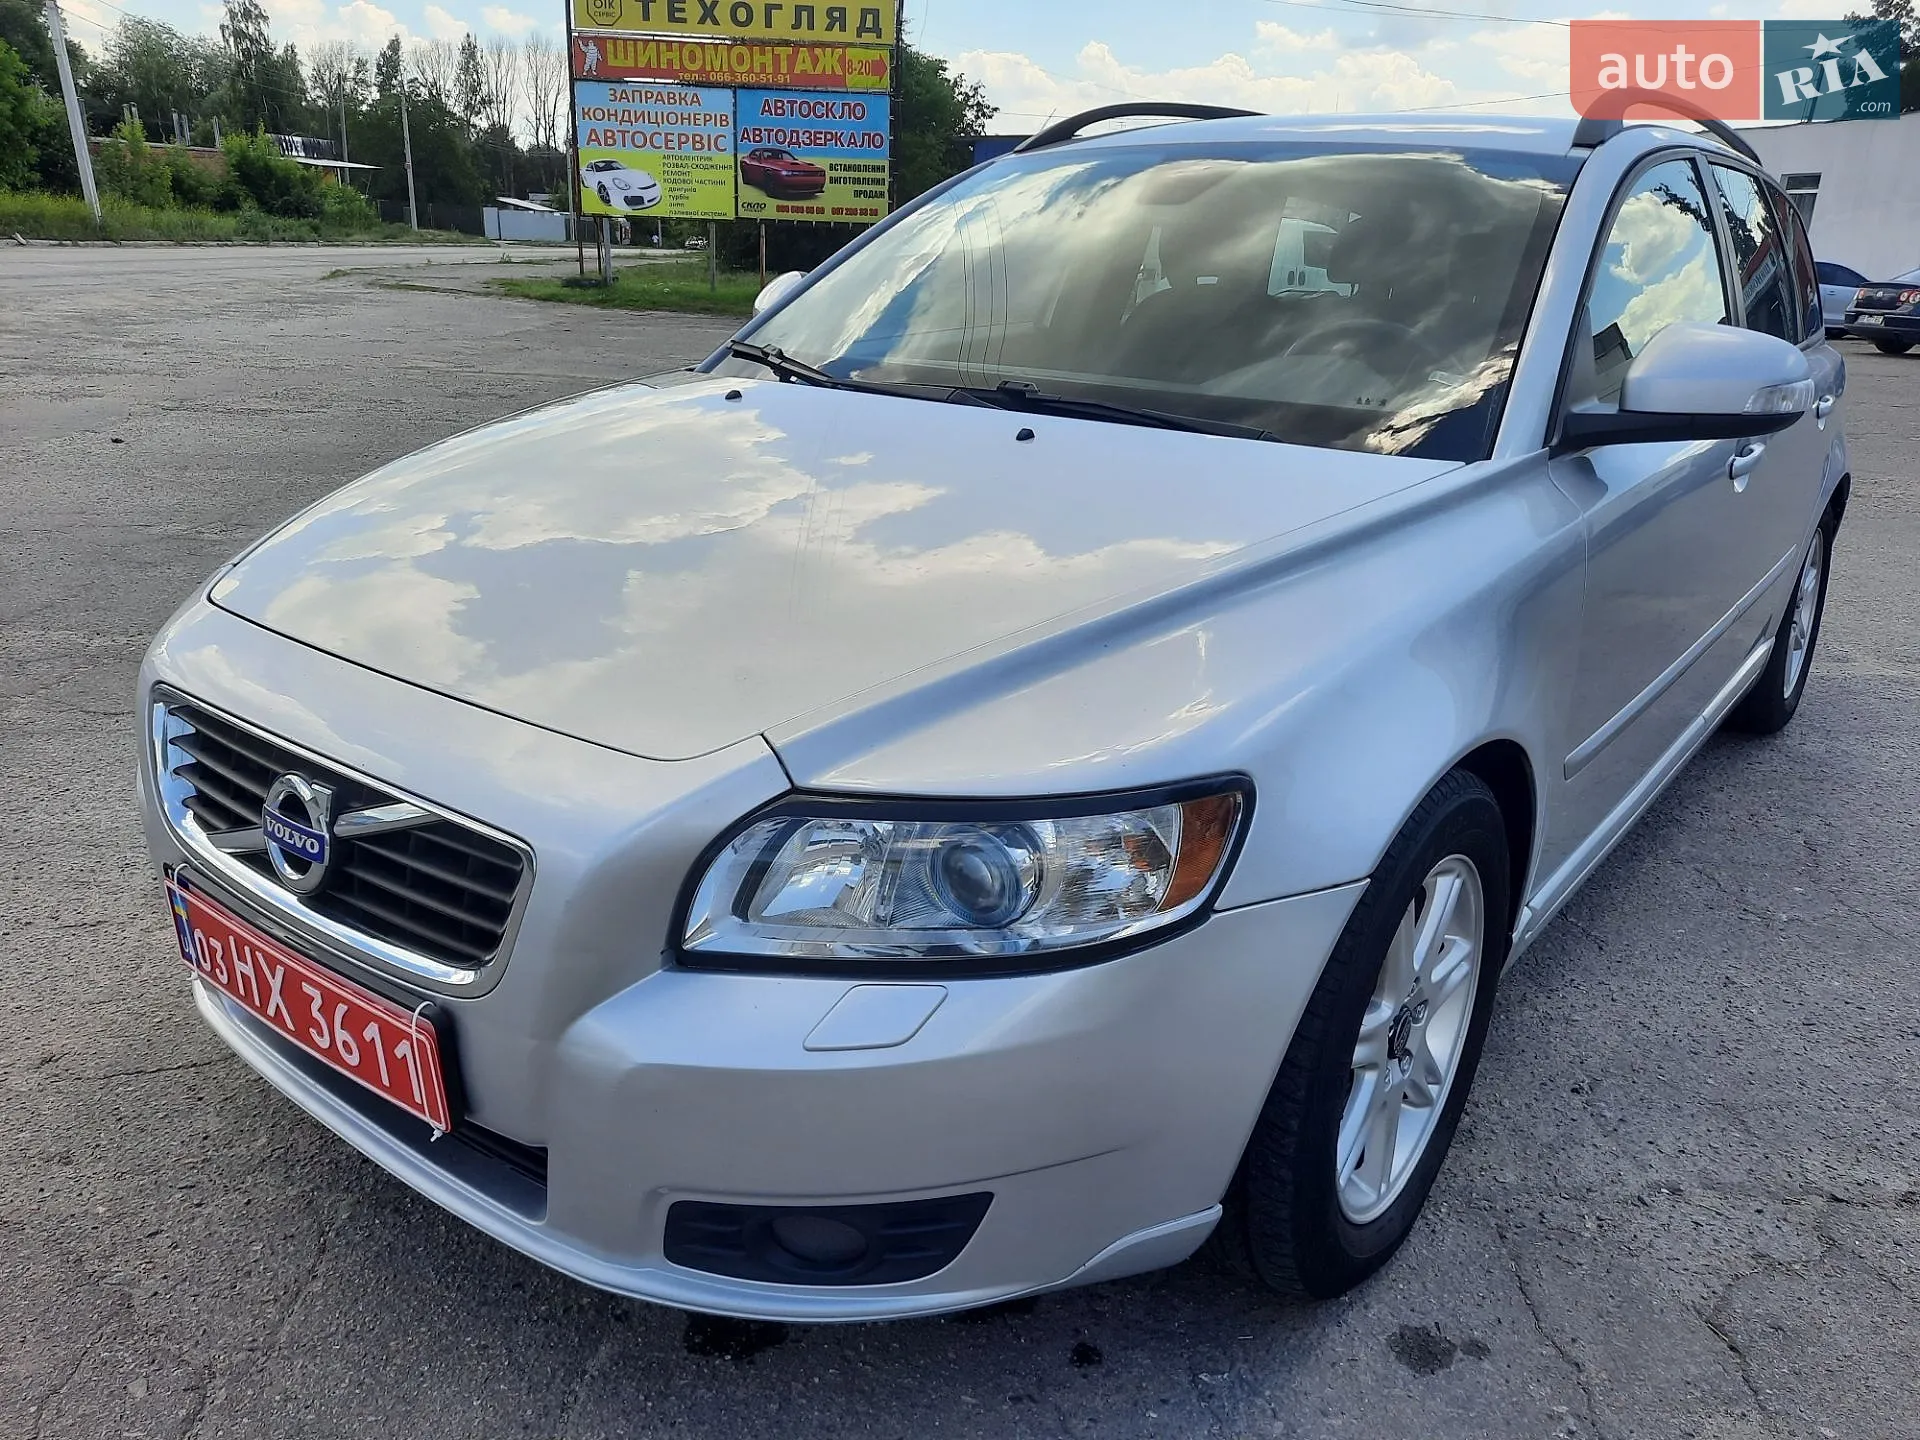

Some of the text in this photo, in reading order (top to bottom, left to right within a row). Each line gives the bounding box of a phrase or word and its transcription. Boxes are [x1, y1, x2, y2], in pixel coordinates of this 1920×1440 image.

[634, 0, 883, 39] ТЕХОГЛЯД
[606, 40, 844, 75] ШИНОМОНТАЖ
[847, 58, 872, 76] 8-20
[709, 72, 791, 83] 066-360-51-91
[608, 88, 703, 107] ЗАПРАВКА
[581, 107, 730, 128] КОНДИЦІОНЕРІВ
[760, 98, 867, 121] АВТОСКЛО
[585, 127, 728, 153] АВТОСЕРВІС
[739, 126, 885, 149] АВТОДЗЕРКАЛО
[829, 163, 886, 173] ВСТАНОВЛЕННЯ
[265, 815, 320, 854] VOLVO
[193, 928, 422, 1104] 03 HX 3611
